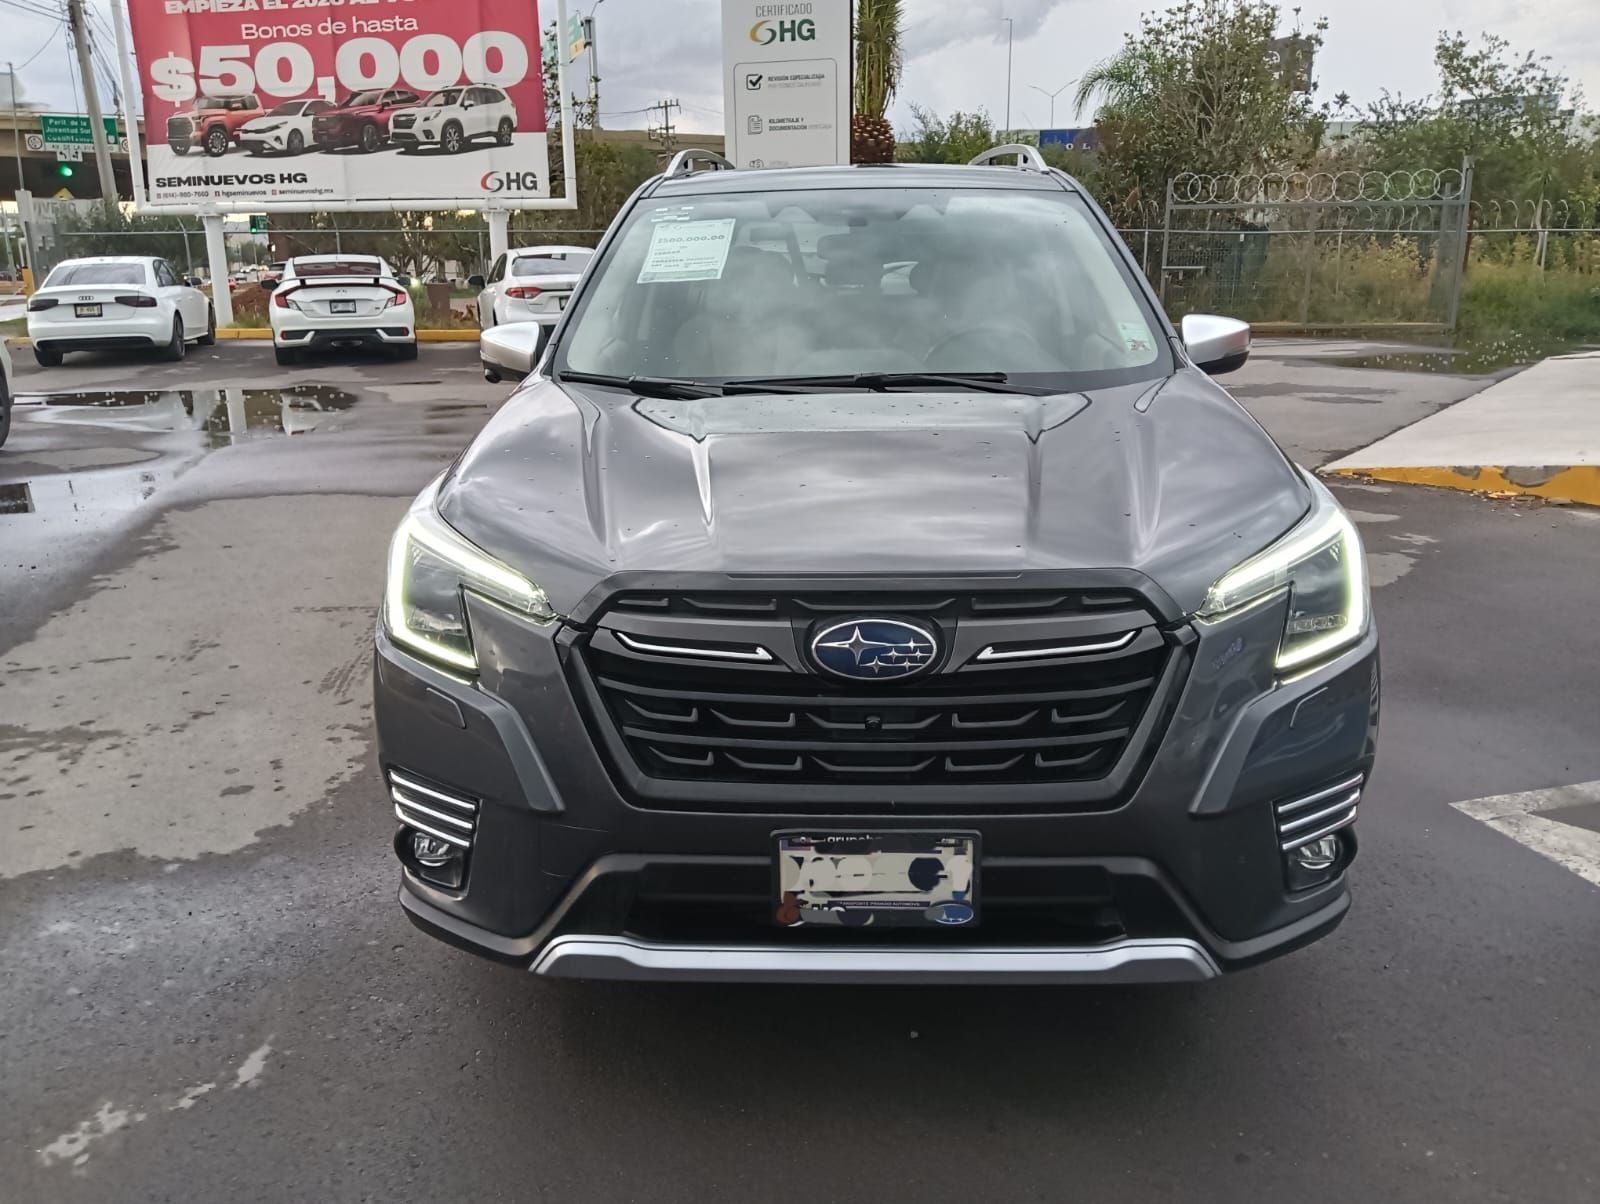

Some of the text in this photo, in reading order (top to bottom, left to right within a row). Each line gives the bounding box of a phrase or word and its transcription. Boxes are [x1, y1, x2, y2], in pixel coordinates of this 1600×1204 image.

[165, 0, 259, 14] EMPIEZA
[755, 3, 812, 17] CERTIFICADO
[241, 15, 418, 40] Bonos de hasta
[779, 18, 816, 42] HG
[150, 31, 529, 107] $50,000
[155, 172, 308, 188] SEMINUEVOS HG
[505, 171, 538, 191] HG
